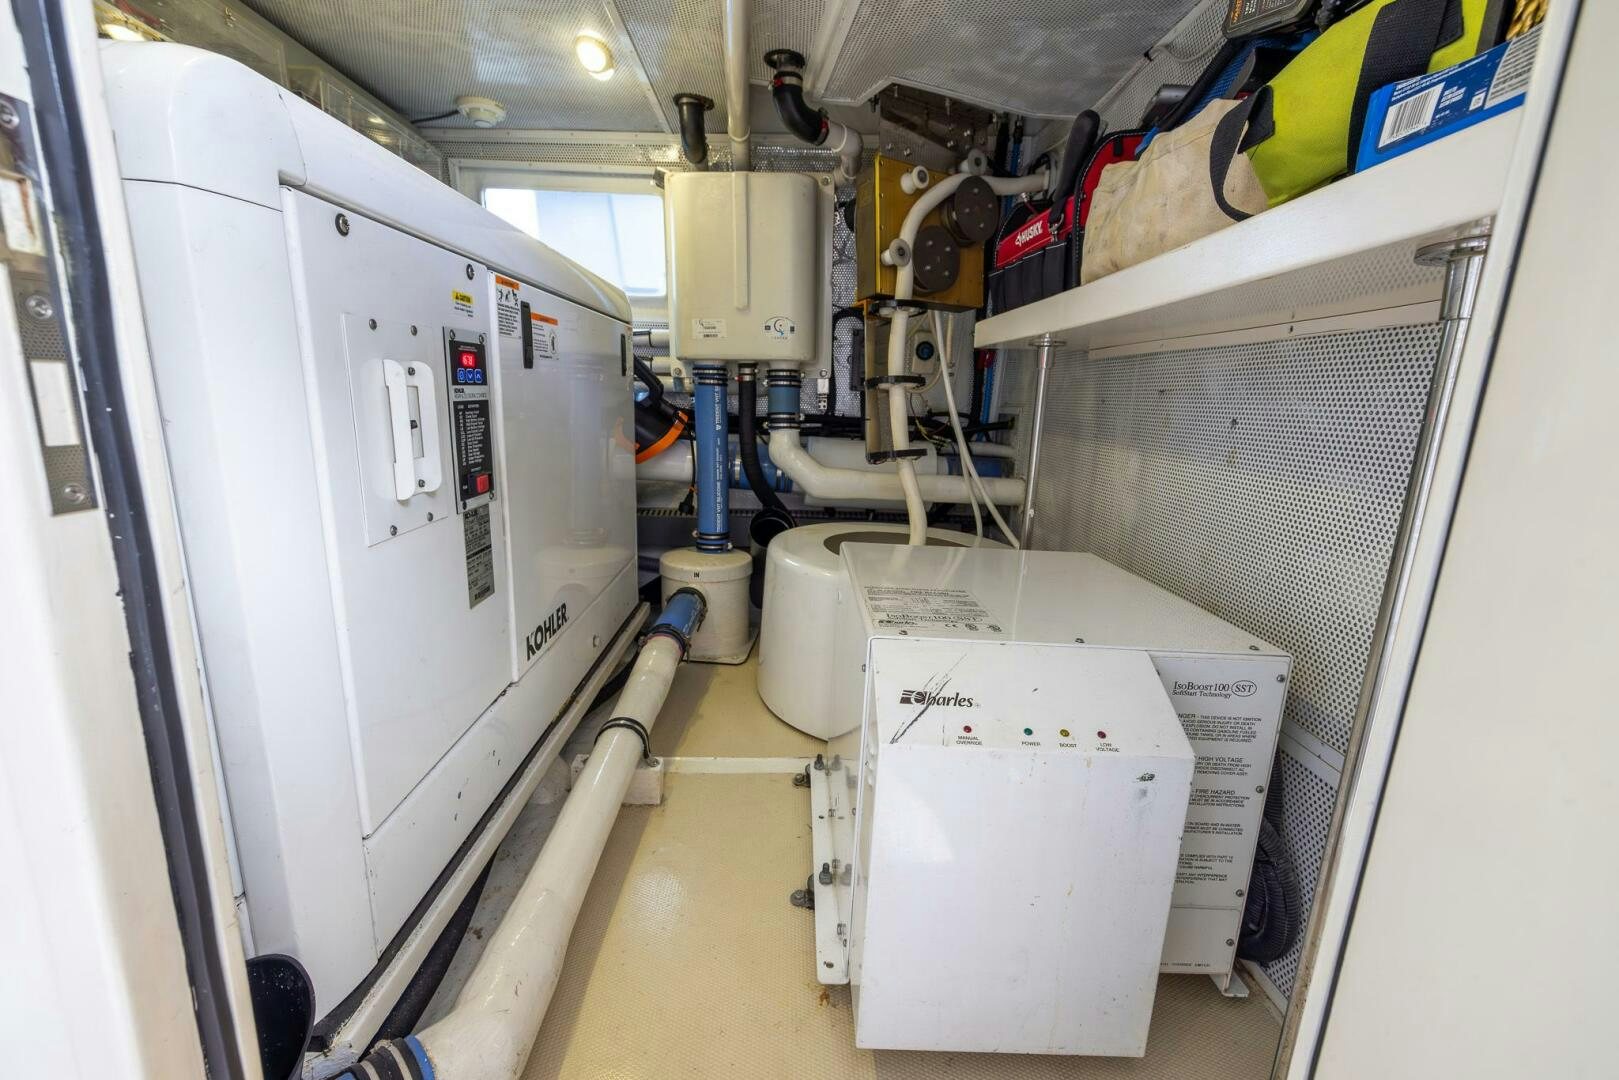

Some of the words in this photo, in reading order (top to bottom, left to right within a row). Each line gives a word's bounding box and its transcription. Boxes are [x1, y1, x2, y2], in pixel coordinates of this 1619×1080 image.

[1021, 220, 1043, 244] HUSKY
[526, 602, 568, 661] KOHLER
[1234, 684, 1254, 693] SST
